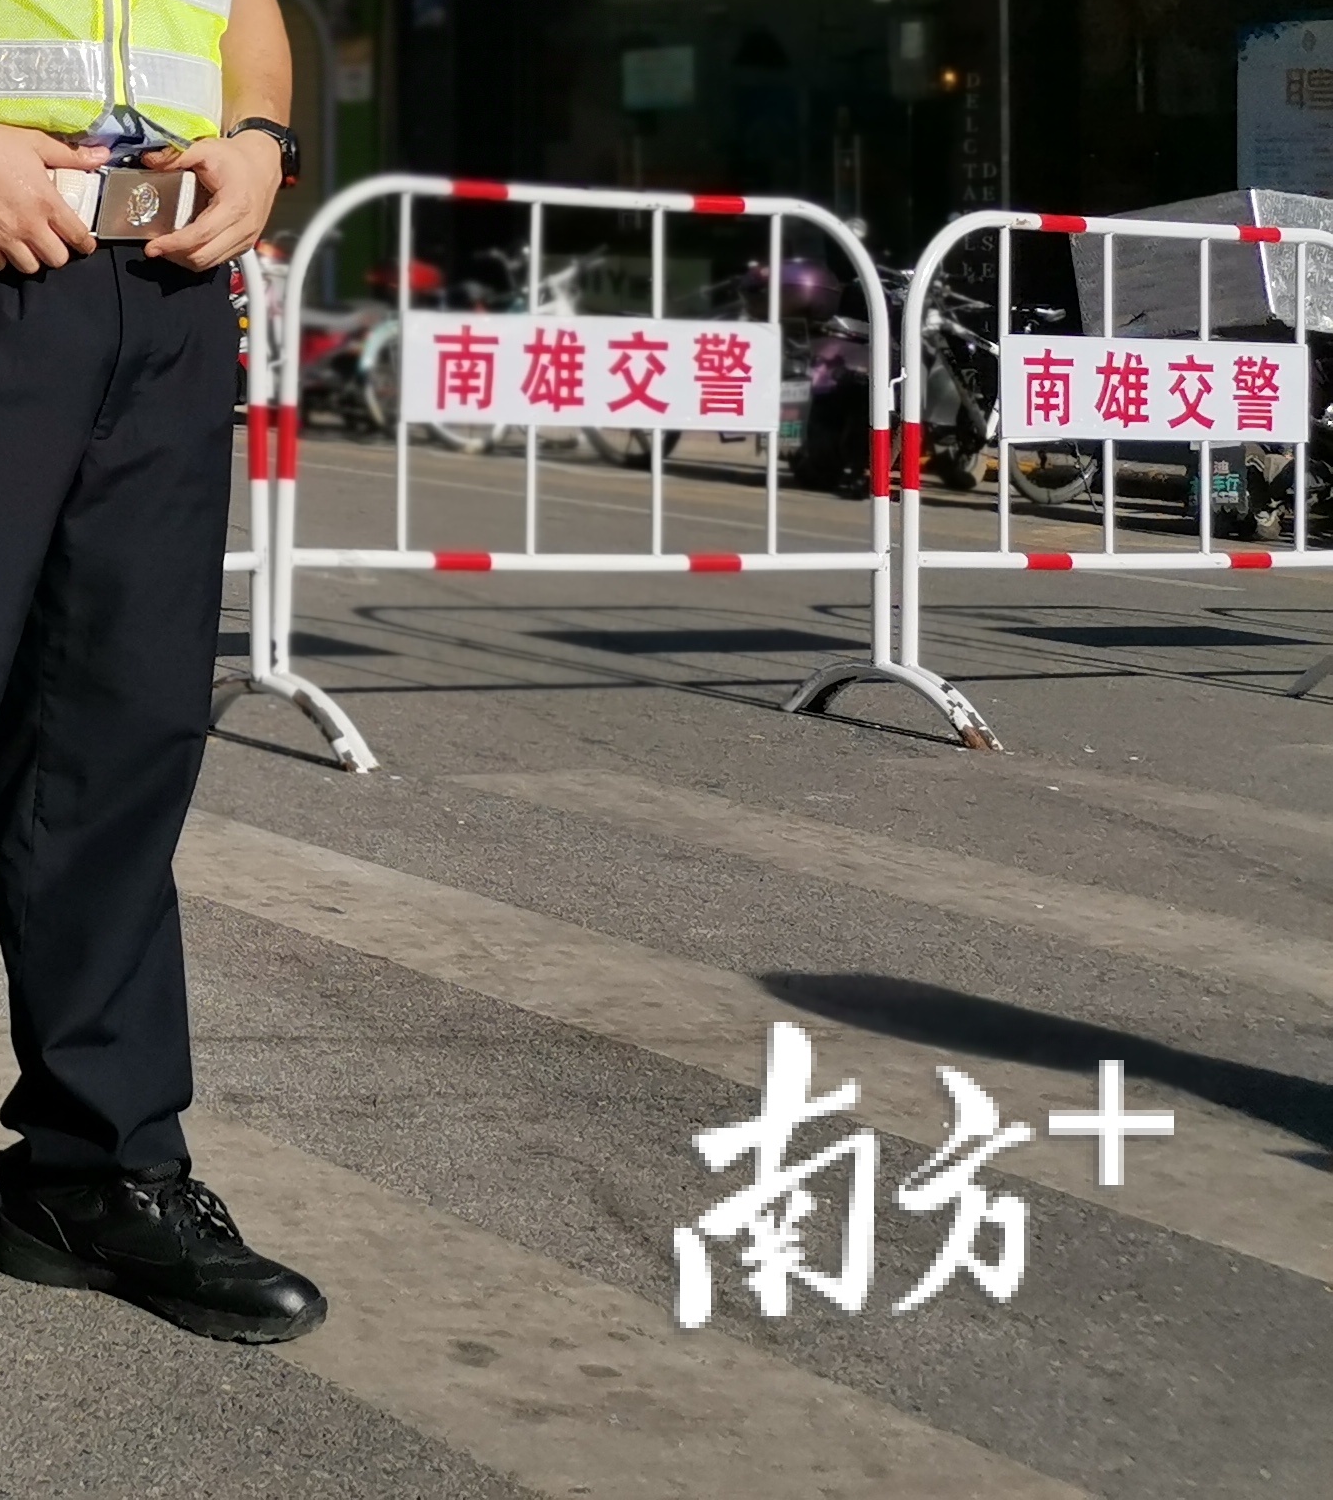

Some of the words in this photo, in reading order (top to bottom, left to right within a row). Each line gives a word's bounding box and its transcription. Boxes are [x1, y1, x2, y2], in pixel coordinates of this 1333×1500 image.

[433, 324, 754, 417] 南雄交警
[1021, 347, 1282, 433] 南雄交警
